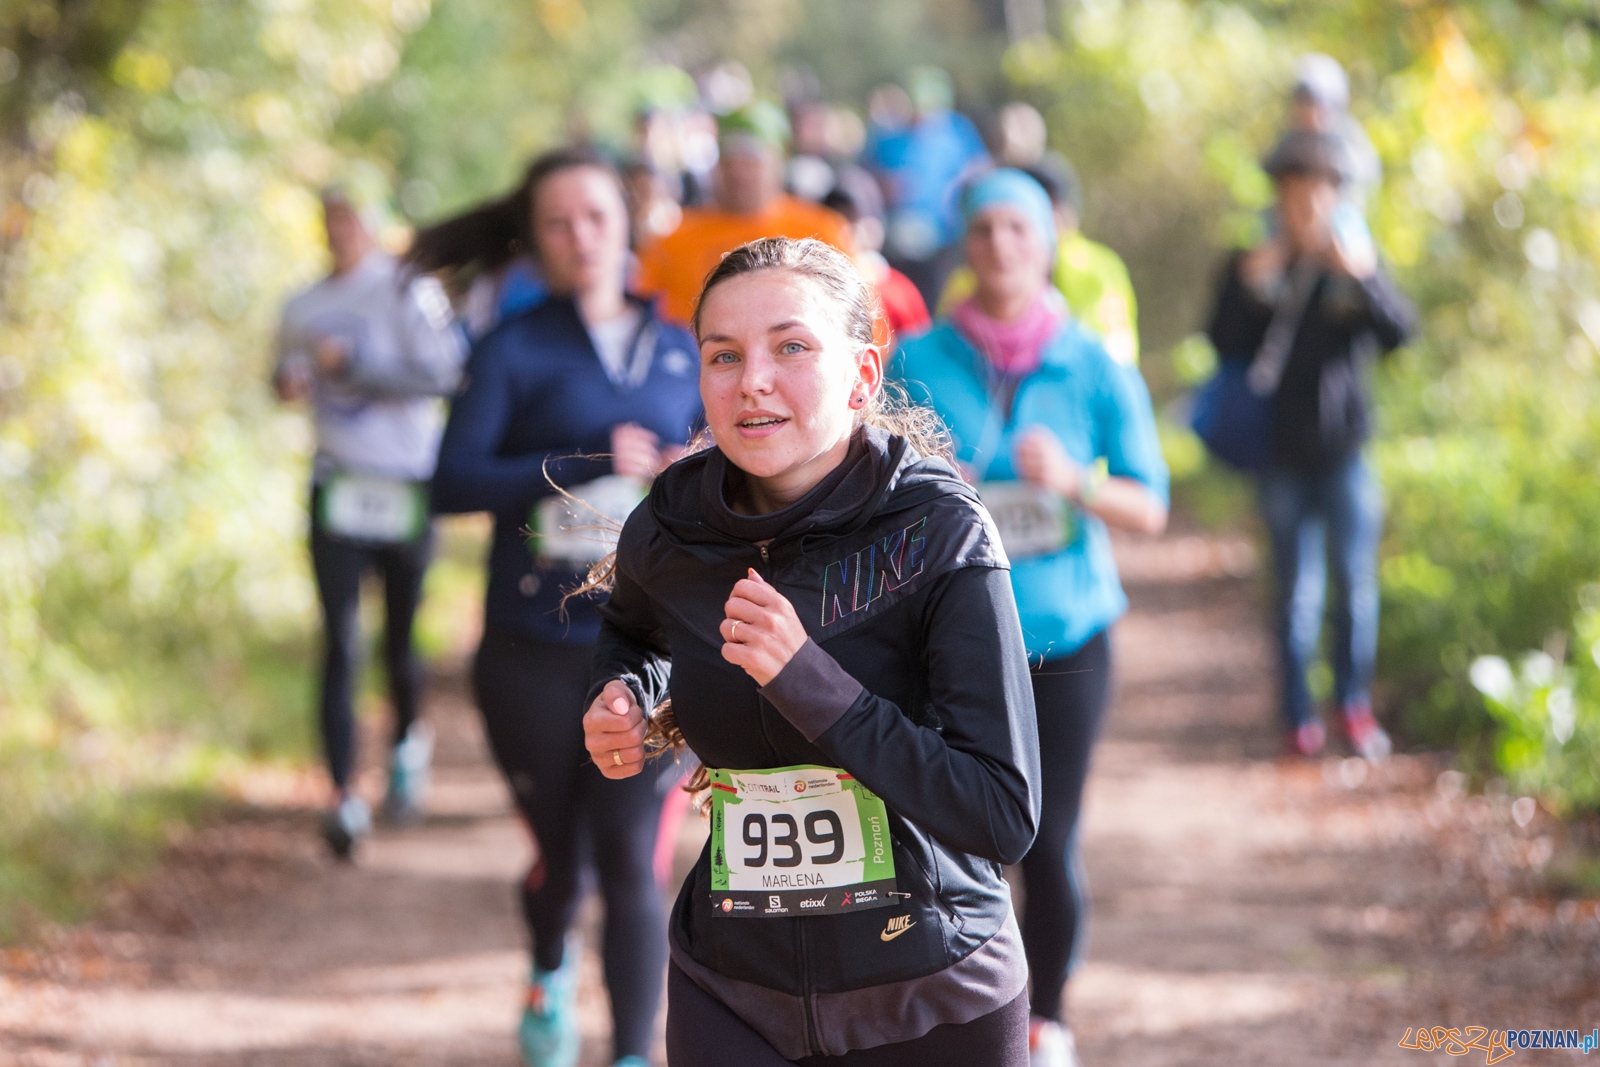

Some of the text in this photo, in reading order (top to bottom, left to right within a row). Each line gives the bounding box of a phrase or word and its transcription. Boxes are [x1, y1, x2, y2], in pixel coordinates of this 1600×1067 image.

[821, 516, 927, 627] NIKE
[743, 809, 844, 867] 939
[867, 816, 885, 864] Poznań
[762, 873, 825, 888] MARLENA
[854, 889, 877, 898] POLSKA
[887, 914, 911, 932] NIKE
